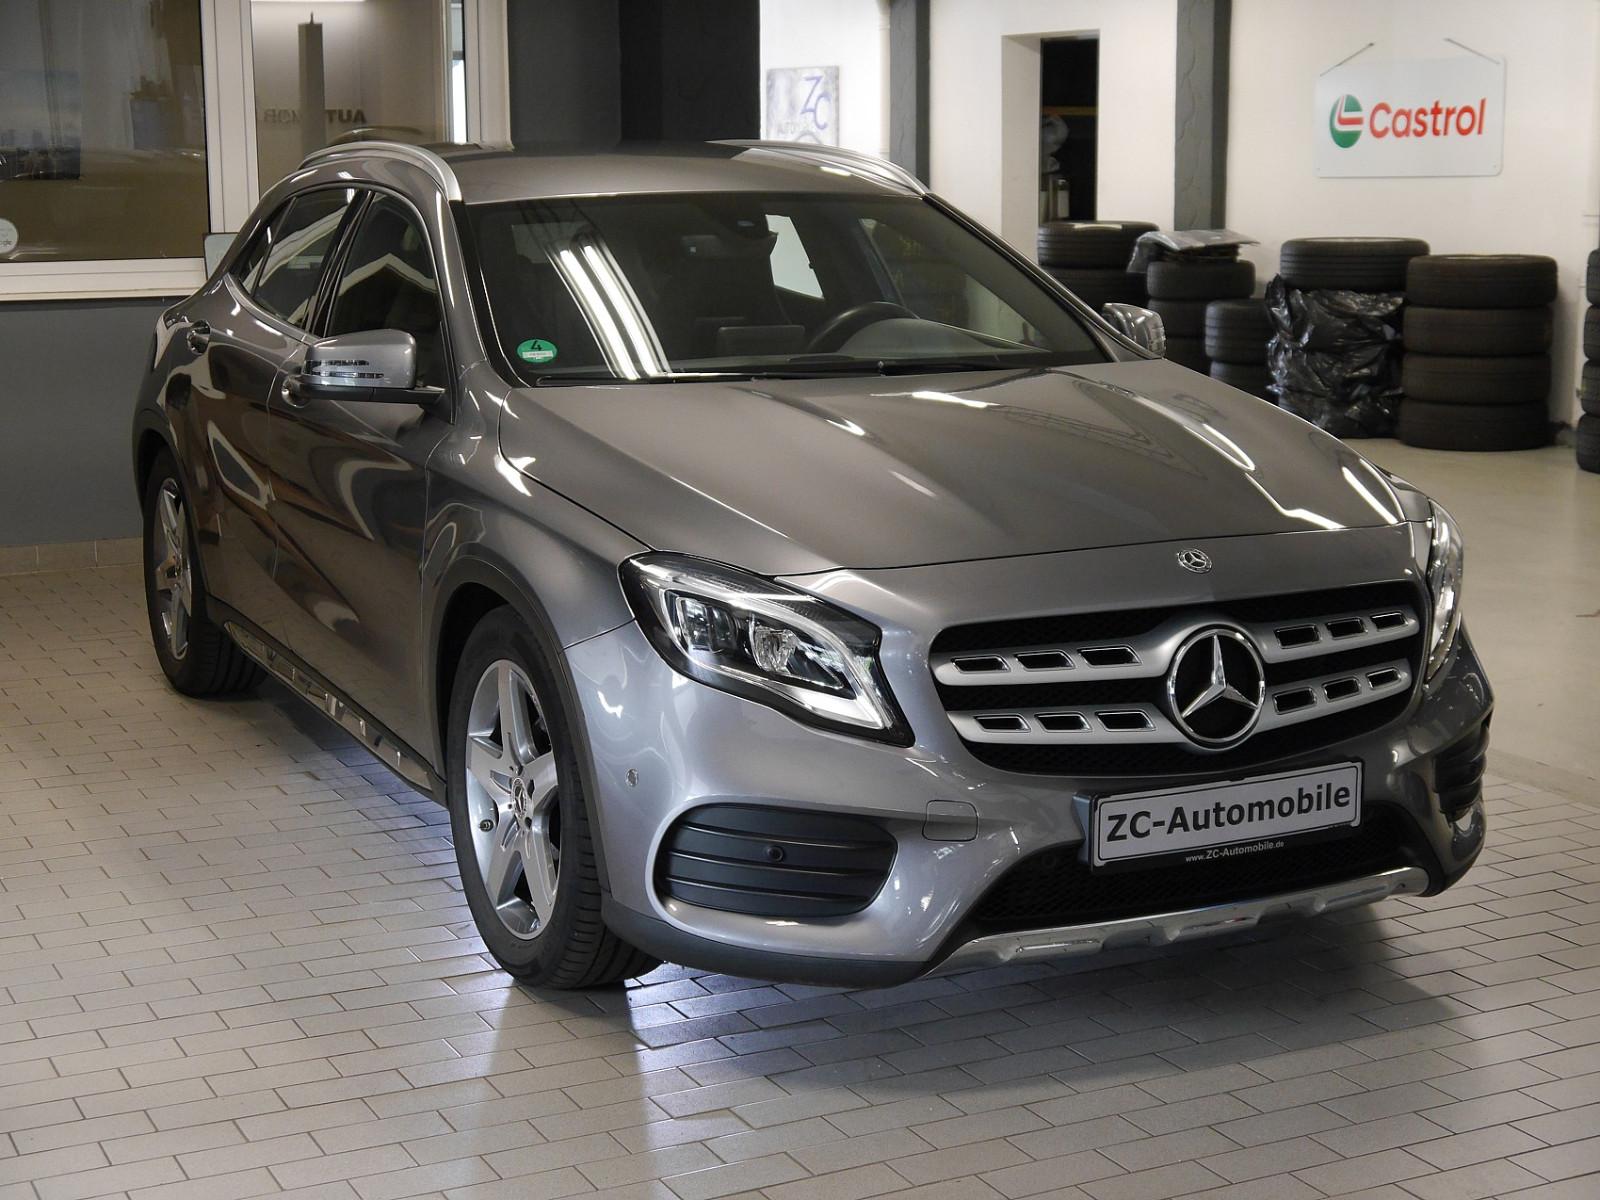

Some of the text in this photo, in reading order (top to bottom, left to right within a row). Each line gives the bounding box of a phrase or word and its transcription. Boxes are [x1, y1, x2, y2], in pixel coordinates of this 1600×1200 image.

[1369, 97, 1487, 139] Castrol
[531, 339, 543, 351] 4
[1106, 782, 1351, 843] ZC-Automobile
[1185, 840, 1285, 863] www.ZC-Automobile.de
